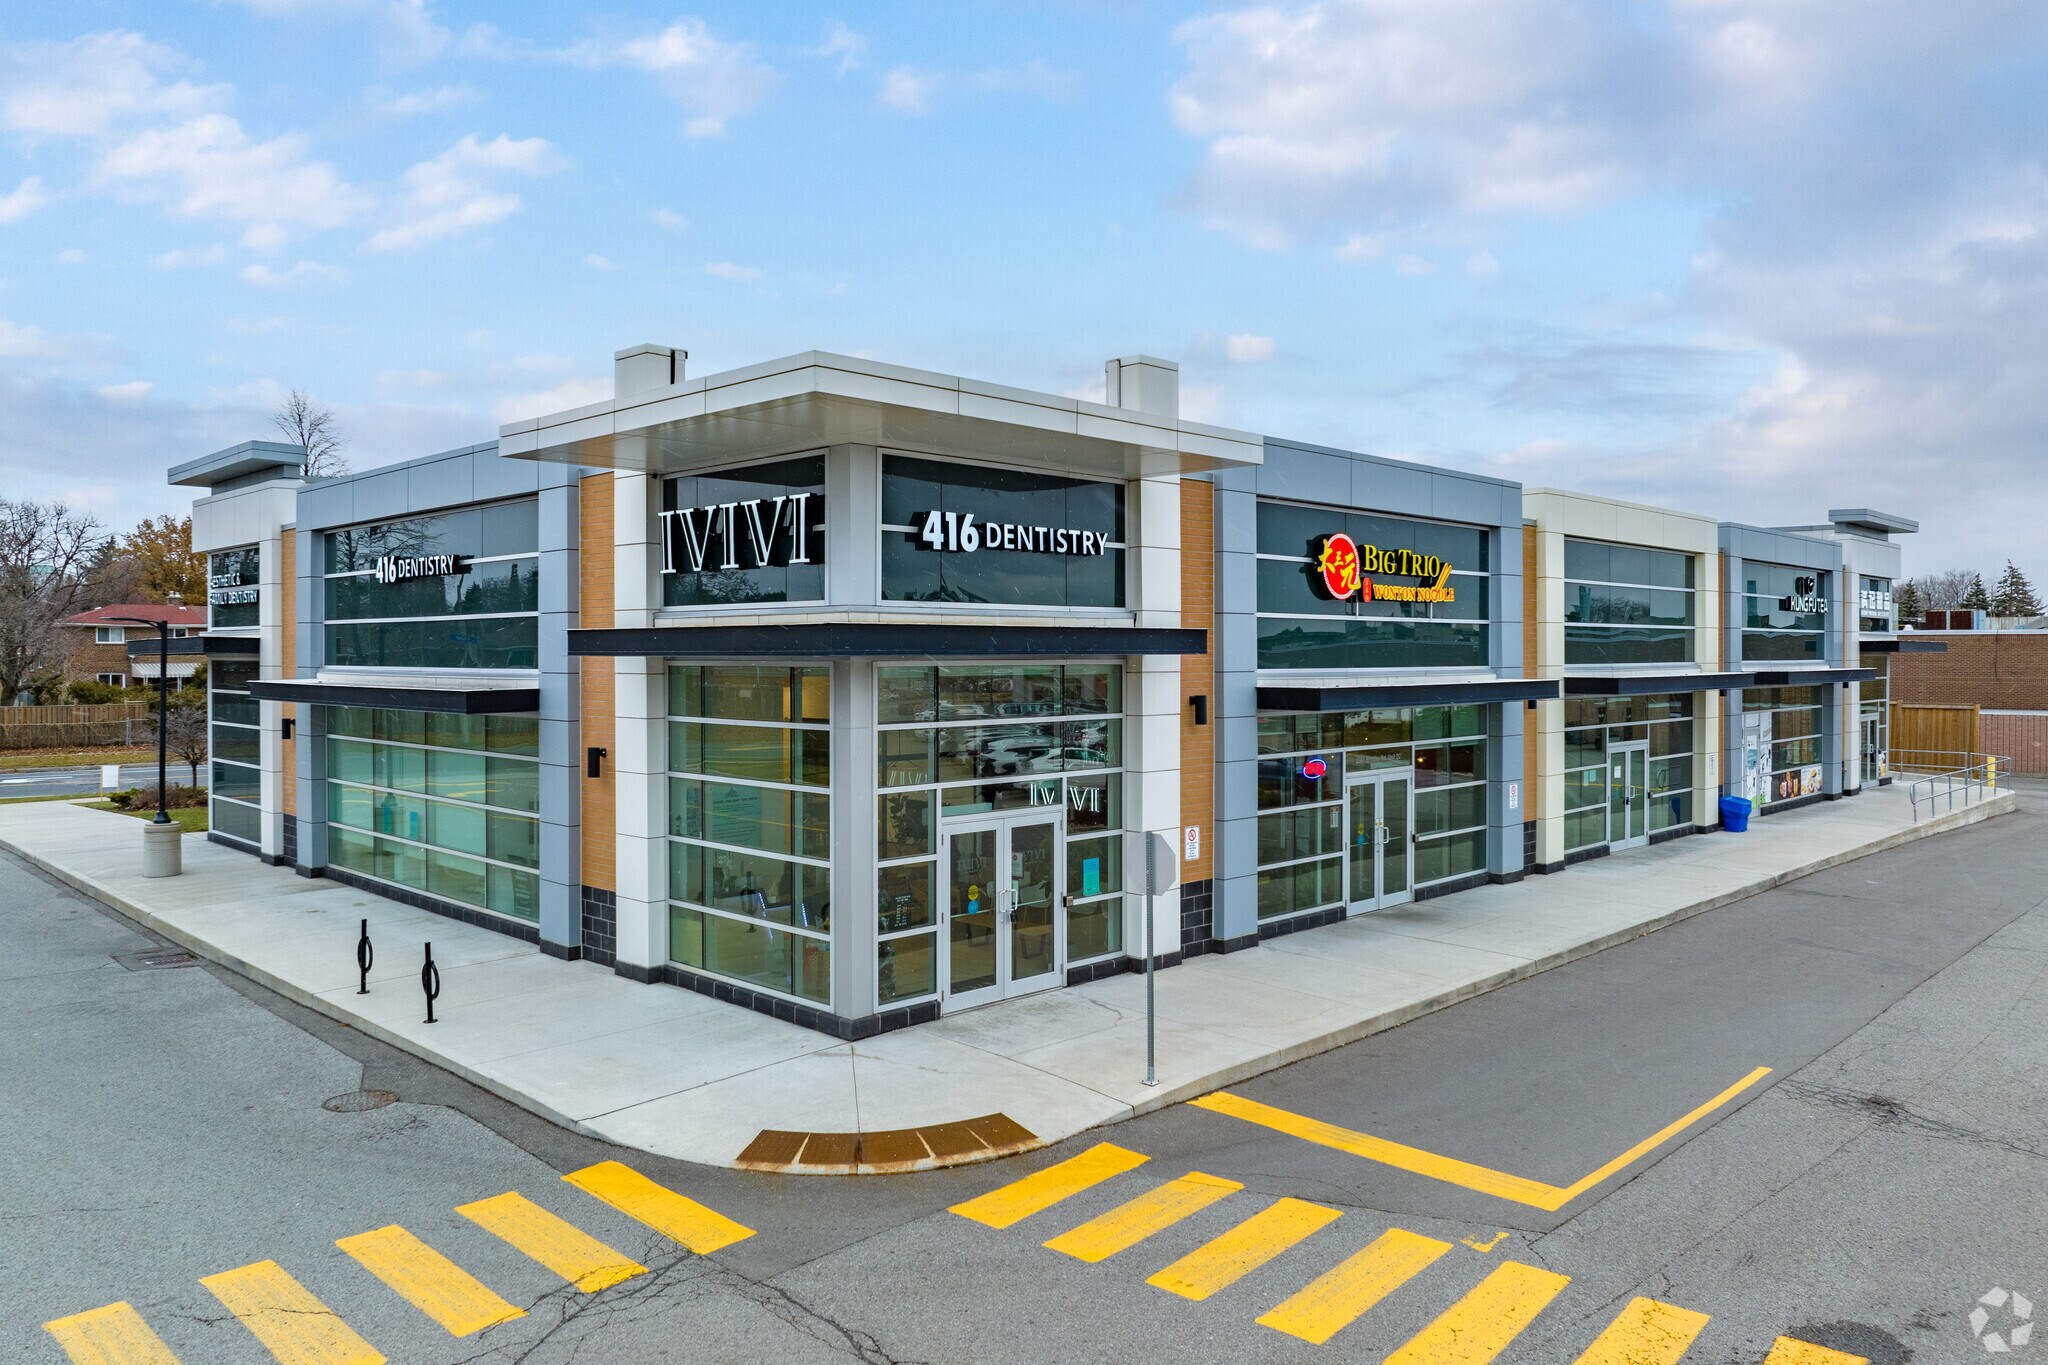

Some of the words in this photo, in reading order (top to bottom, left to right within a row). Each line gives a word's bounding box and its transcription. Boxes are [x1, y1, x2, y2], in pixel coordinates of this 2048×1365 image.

[658, 493, 811, 574] IVIVI
[922, 510, 980, 552] 416
[986, 522, 1109, 556] DENTISTRY
[375, 555, 397, 584] 416
[398, 555, 454, 578] DENTISTRY
[1317, 538, 1361, 590] 大三元
[228, 589, 258, 604] DENTISTRY
[1373, 584, 1416, 602] WONTON
[1417, 587, 1455, 603] NOODLE
